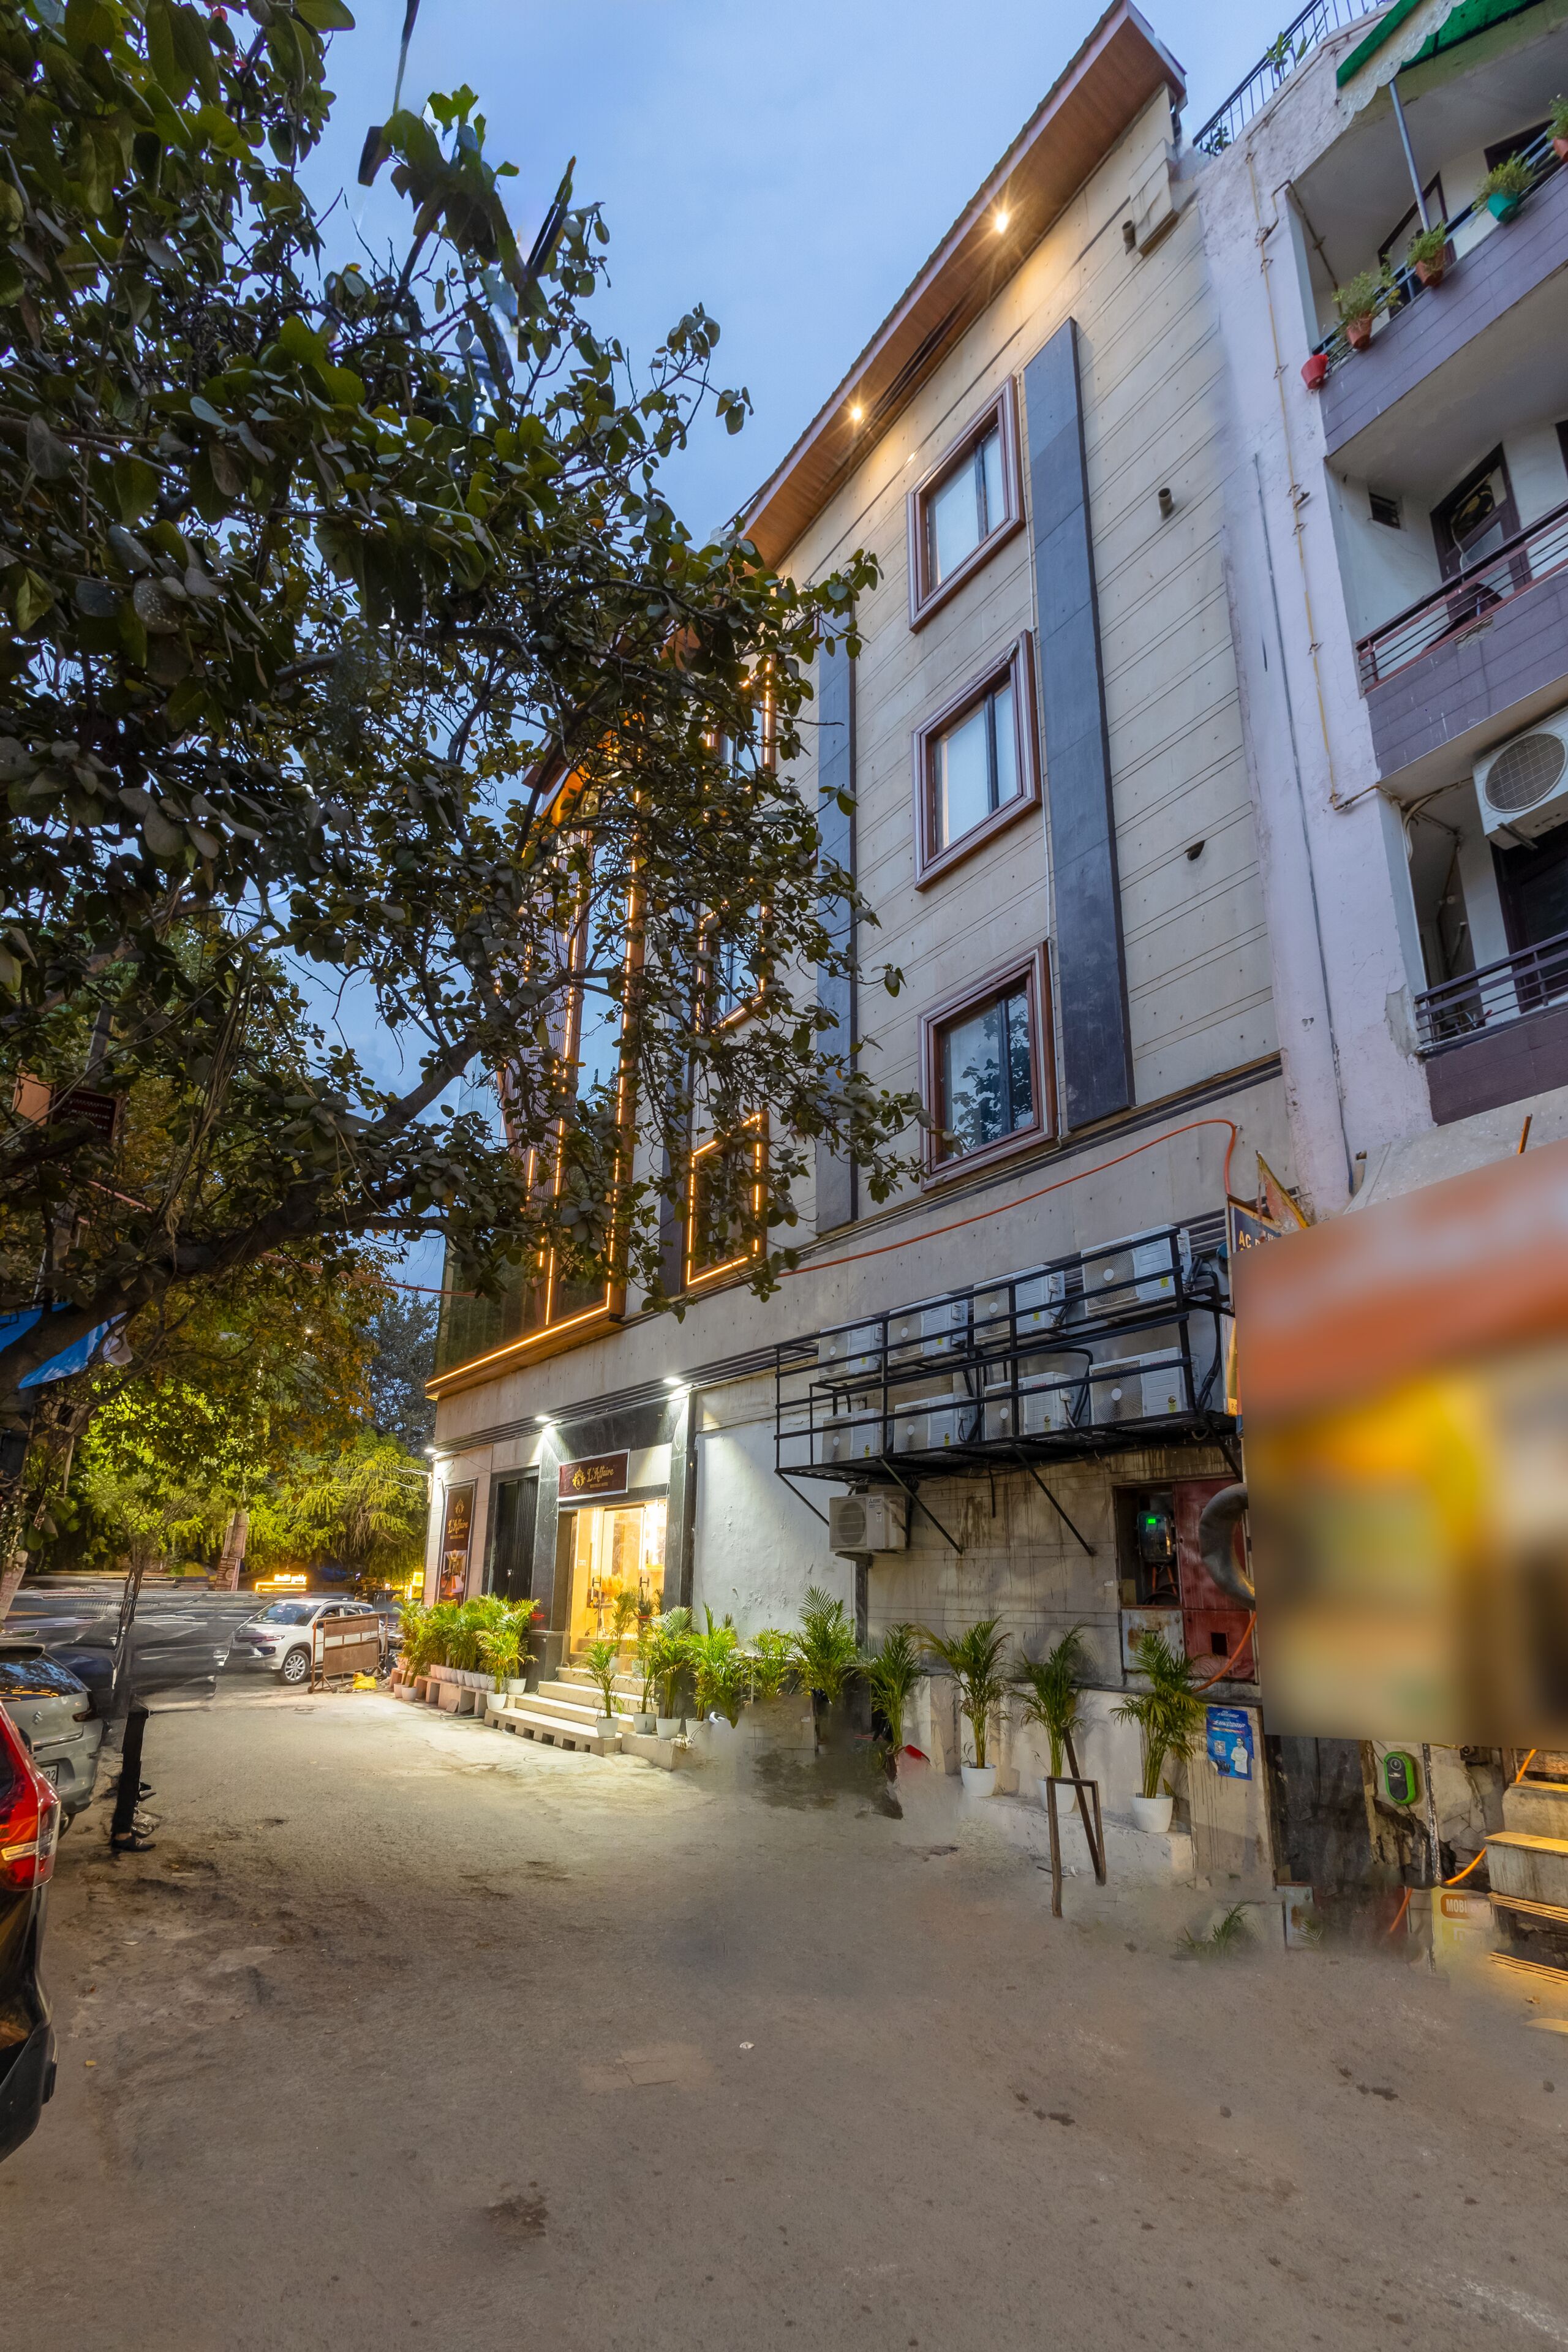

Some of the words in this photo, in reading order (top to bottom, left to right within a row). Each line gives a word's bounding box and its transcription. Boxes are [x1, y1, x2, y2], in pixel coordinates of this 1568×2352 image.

[1238, 1231, 1251, 1248] AC
[587, 1465, 614, 1482] L'Affaire
[447, 1518, 469, 1534] L'Affaire
